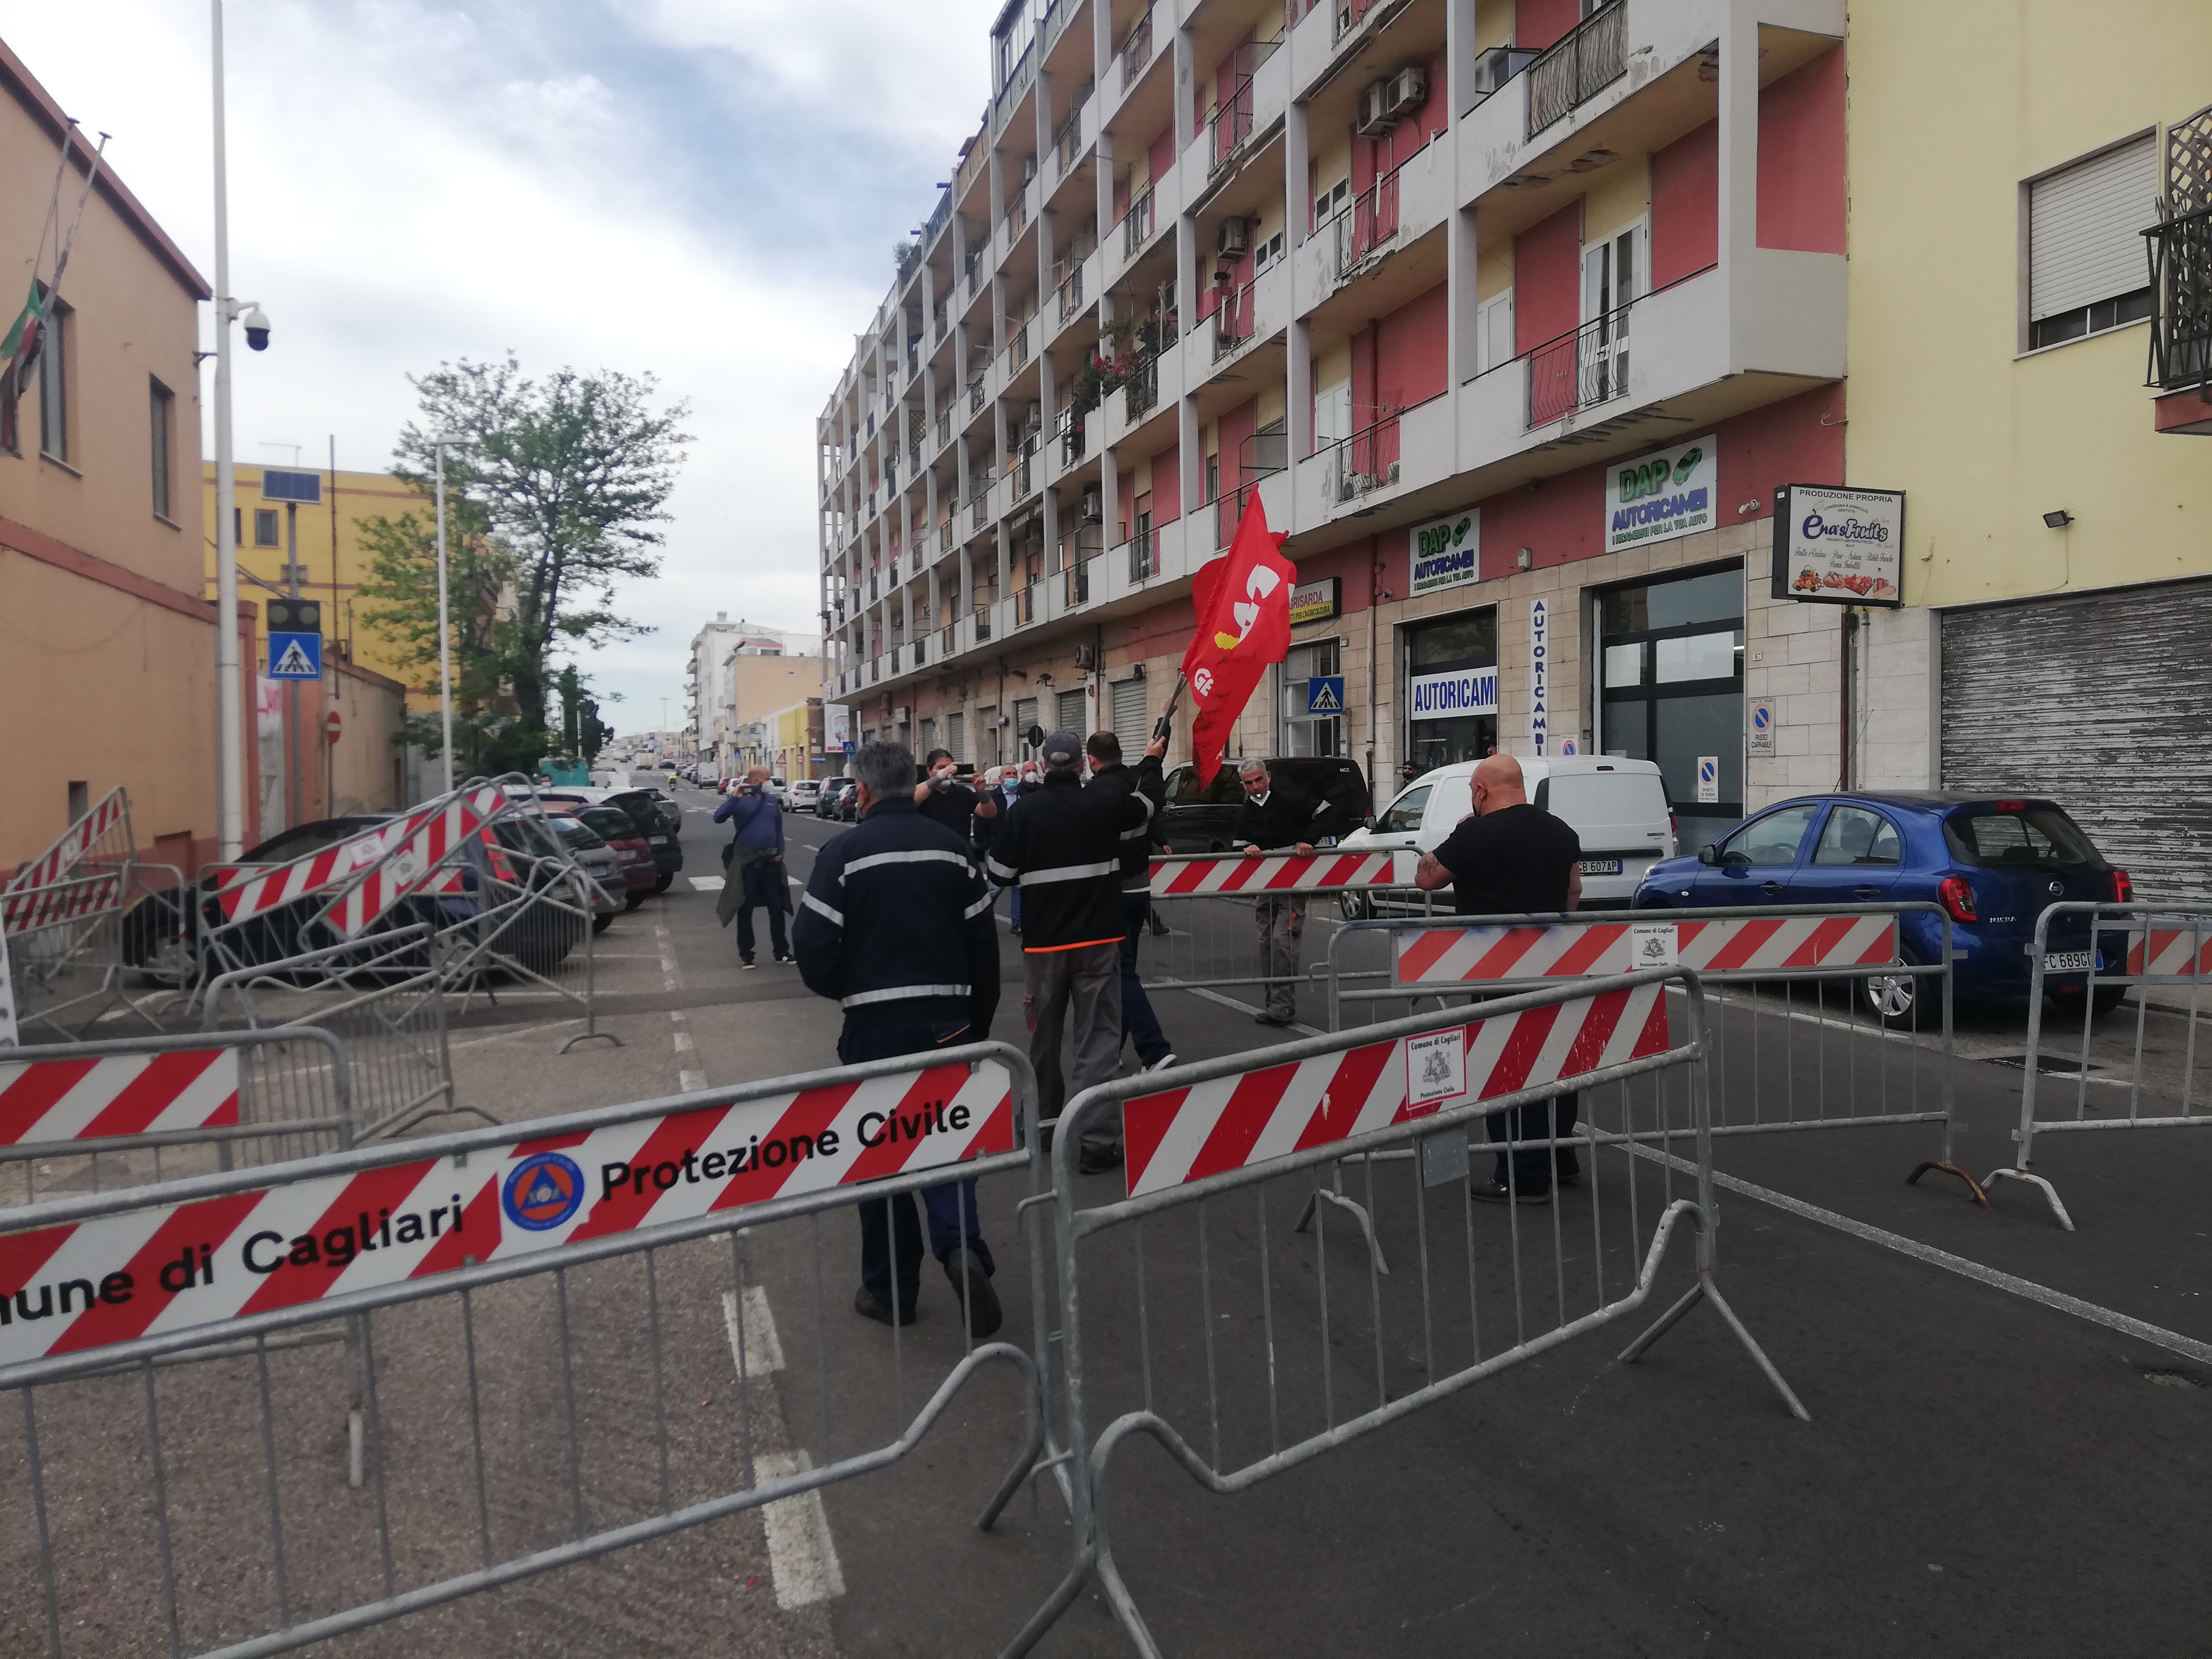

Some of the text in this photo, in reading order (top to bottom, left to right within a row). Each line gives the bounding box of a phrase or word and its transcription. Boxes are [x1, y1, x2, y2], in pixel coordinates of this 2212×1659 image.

[1620, 459, 1670, 502] DAP
[1800, 489, 1892, 503] PRODUZIONE PROPRIA
[1612, 487, 1707, 531] AUTORICAMBI
[1849, 505, 1868, 514] DOMICILIO
[1616, 527, 1649, 544] RICAMBISTI
[1650, 524, 1663, 536] PER
[1663, 521, 1673, 532] LA
[1674, 518, 1687, 529] TUA
[1688, 513, 1707, 527] AUTO
[1419, 525, 1450, 558] DAP
[1415, 549, 1474, 581] AUTORICAMBI
[1447, 575, 1452, 583] LA
[1453, 572, 1461, 581] TUA
[1462, 569, 1474, 579] AUTO
[1302, 605, 1330, 618] L'AGRICOLTURA
[1533, 601, 1546, 756] AUTORICAMBI
[1591, 862, 1616, 872] 607AP
[1411, 1040, 1432, 1050] Comune
[1441, 1032, 1461, 1045] Cagliari
[1420, 1085, 1455, 1099] Protezione Civile
[160, 1243, 215, 1292] di
[241, 1194, 463, 1274] Cagliari
[601, 1129, 840, 1202] Protezione
[857, 1101, 971, 1149] Civile
